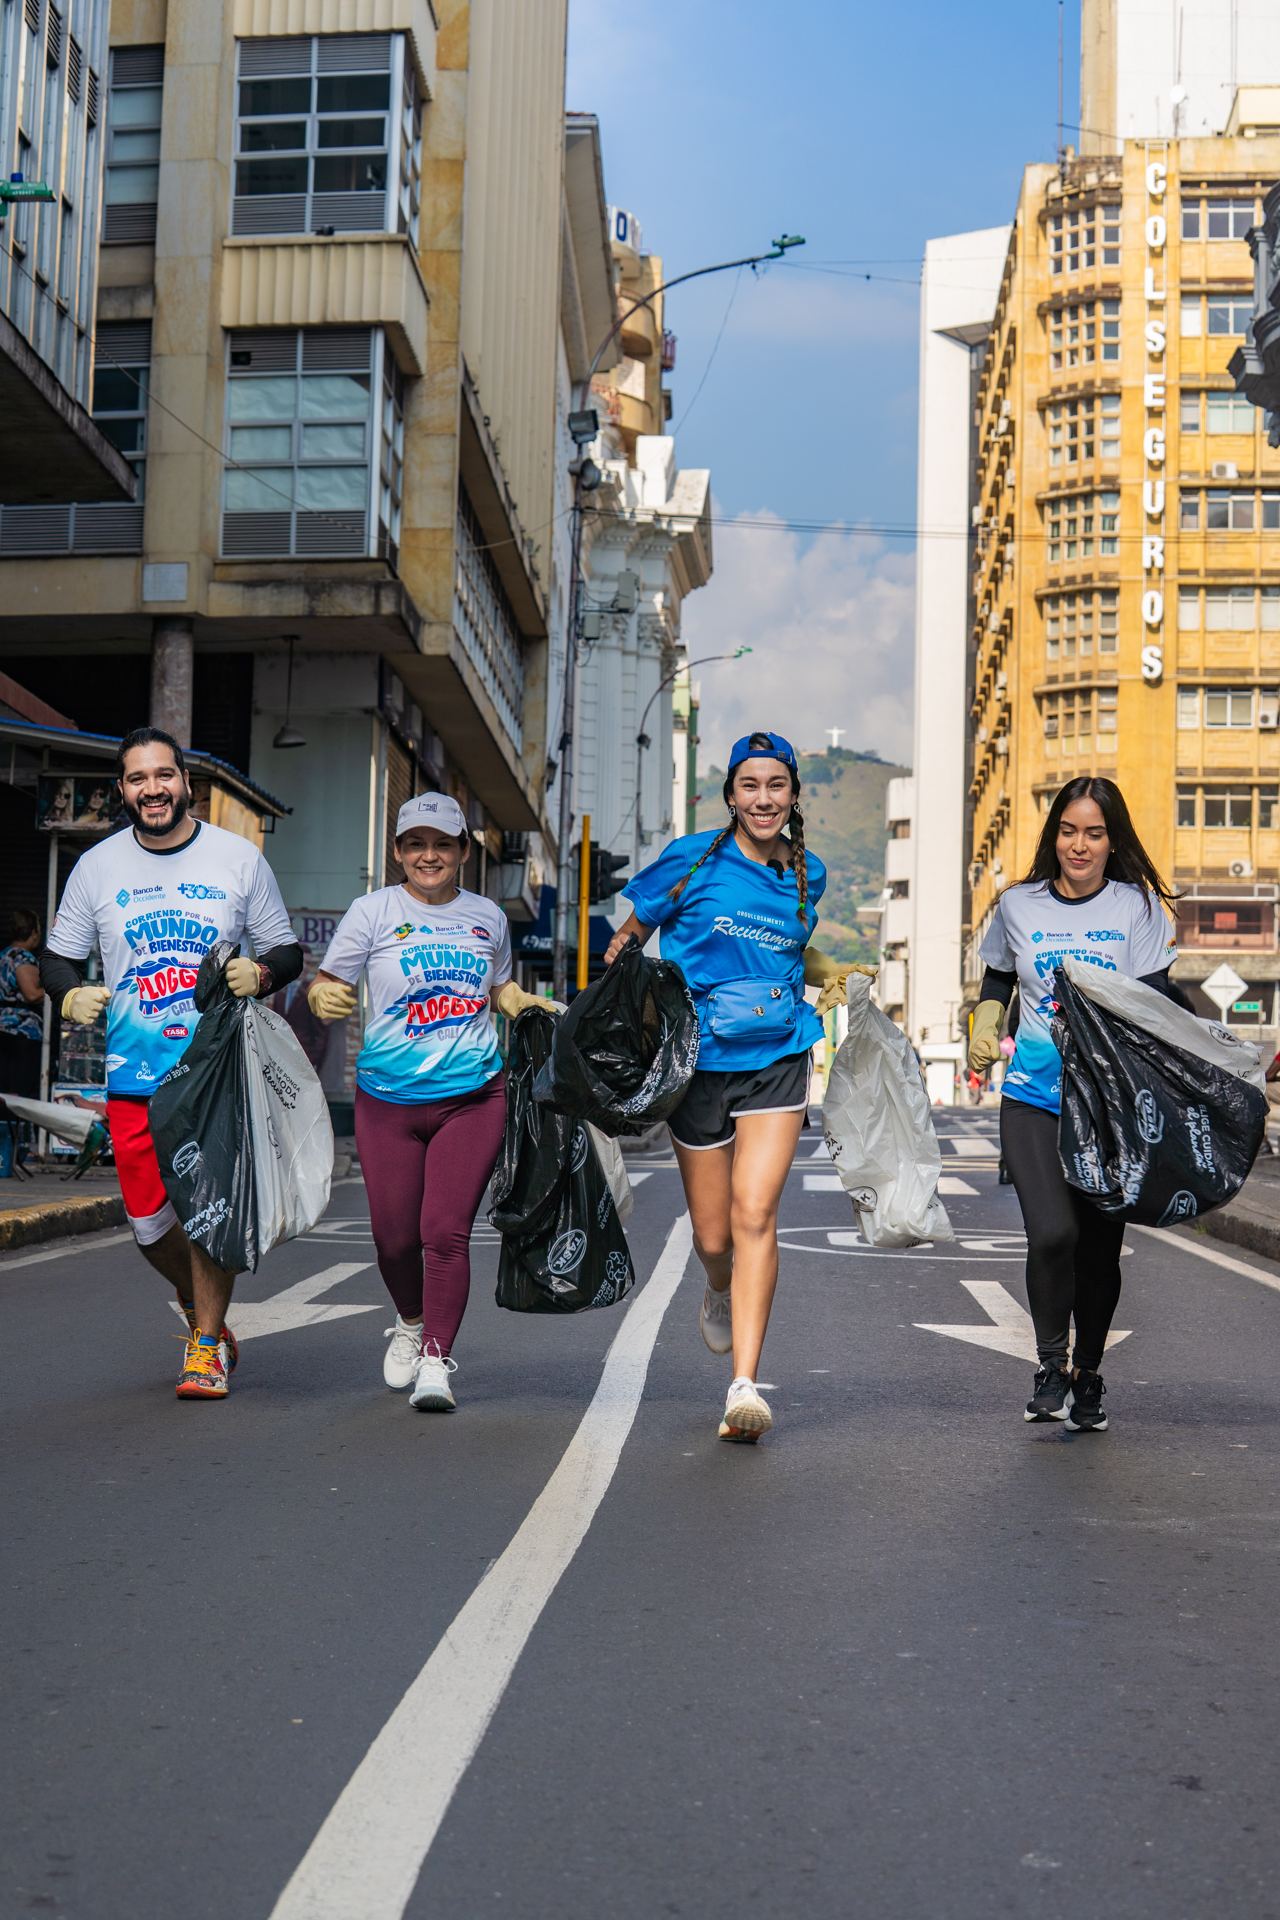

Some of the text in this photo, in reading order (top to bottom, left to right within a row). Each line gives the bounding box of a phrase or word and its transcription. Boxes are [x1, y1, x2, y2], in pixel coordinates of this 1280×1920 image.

[1141, 162, 1167, 680] COLSEGUROS
[133, 884, 162, 896] Banco de
[133, 893, 166, 904] Occidente
[125, 910, 214, 929] CORRIENDO POR UN
[124, 918, 218, 950] MUNDO
[134, 939, 210, 957] DE BIENESTAR
[402, 944, 458, 956] CORRIENDO
[1036, 949, 1087, 960] CORRIENDO
[400, 950, 488, 977] MUNDO
[136, 967, 199, 1000] PLOGG
[408, 969, 482, 990] DE BIENESTAR
[1044, 976, 1056, 987] DE
[165, 1028, 186, 1036] TASK
[437, 1027, 460, 1041] CALI
[172, 1064, 190, 1078] ELIGE
[276, 1066, 284, 1075] SE
[283, 1073, 300, 1093] PONGA
[1199, 1104, 1216, 1174] ELIGE CUIDAR
